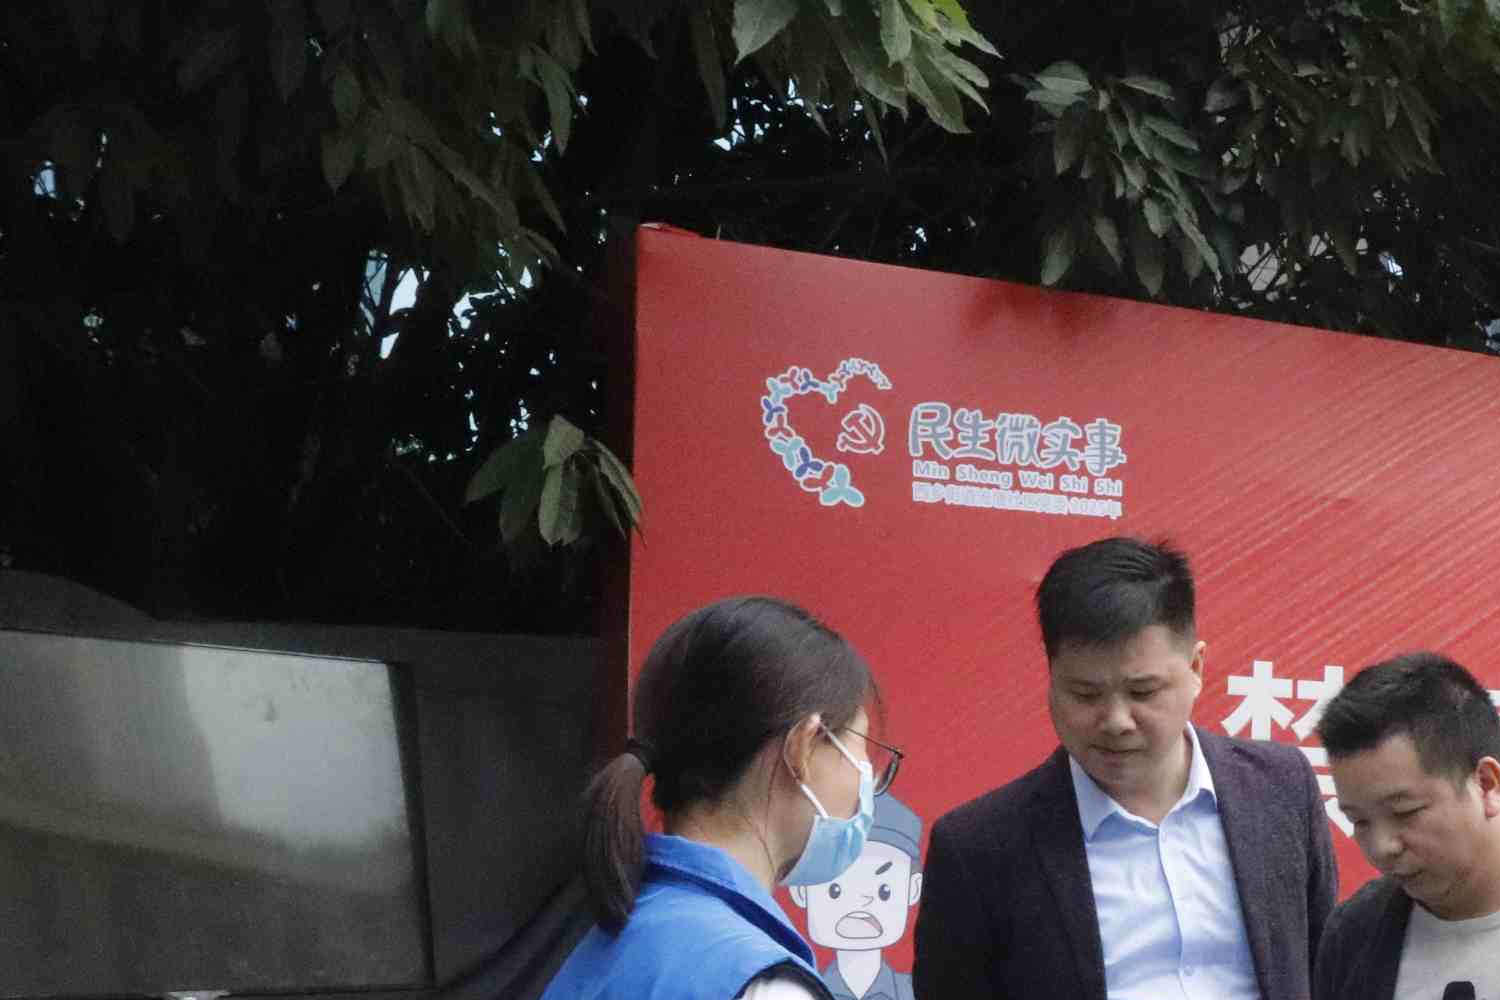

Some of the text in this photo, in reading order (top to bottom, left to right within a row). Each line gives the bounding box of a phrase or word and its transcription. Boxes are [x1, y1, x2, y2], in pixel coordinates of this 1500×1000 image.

[908, 402, 1127, 476] 民生微实事
[913, 461, 1123, 496] Min Sheng Wei Shi Shi
